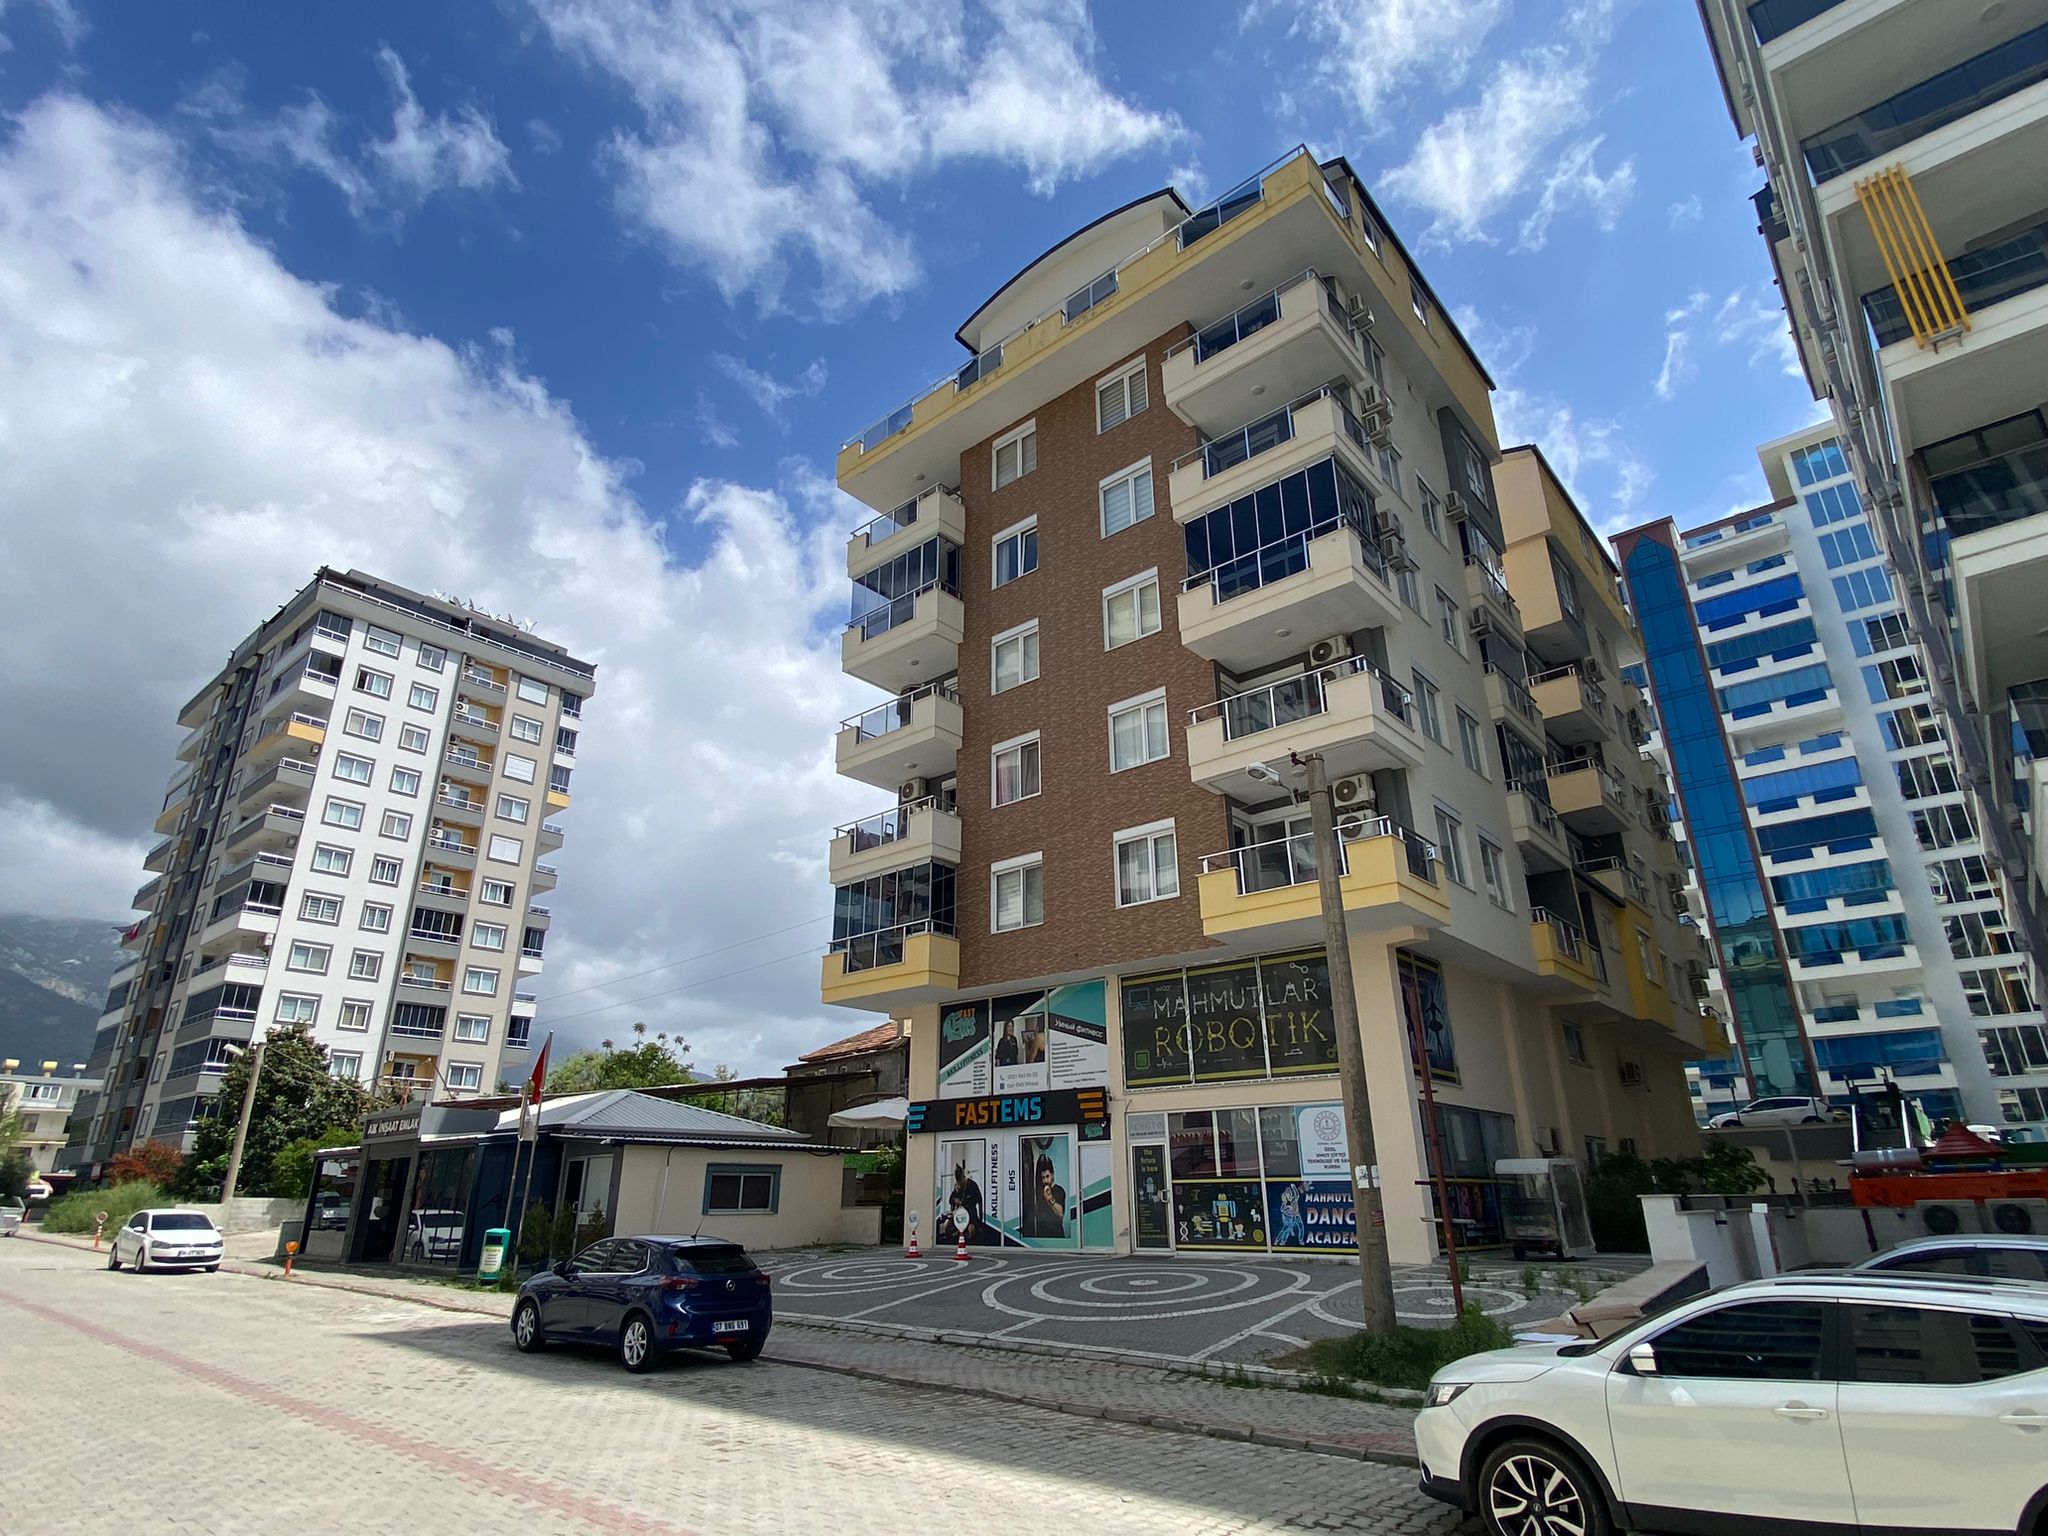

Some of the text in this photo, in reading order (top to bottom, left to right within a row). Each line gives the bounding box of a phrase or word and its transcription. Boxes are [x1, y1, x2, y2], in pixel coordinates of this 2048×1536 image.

[1153, 977, 1319, 1020] MAHMUTLAR
[399, 1117, 420, 1131] EMLAK
[1008, 1169, 1016, 1191] EMS
[1305, 1192, 1353, 1203] MAHMUTL
[1306, 1207, 1357, 1225] DANC
[1306, 1230, 1359, 1244] ACADEM
